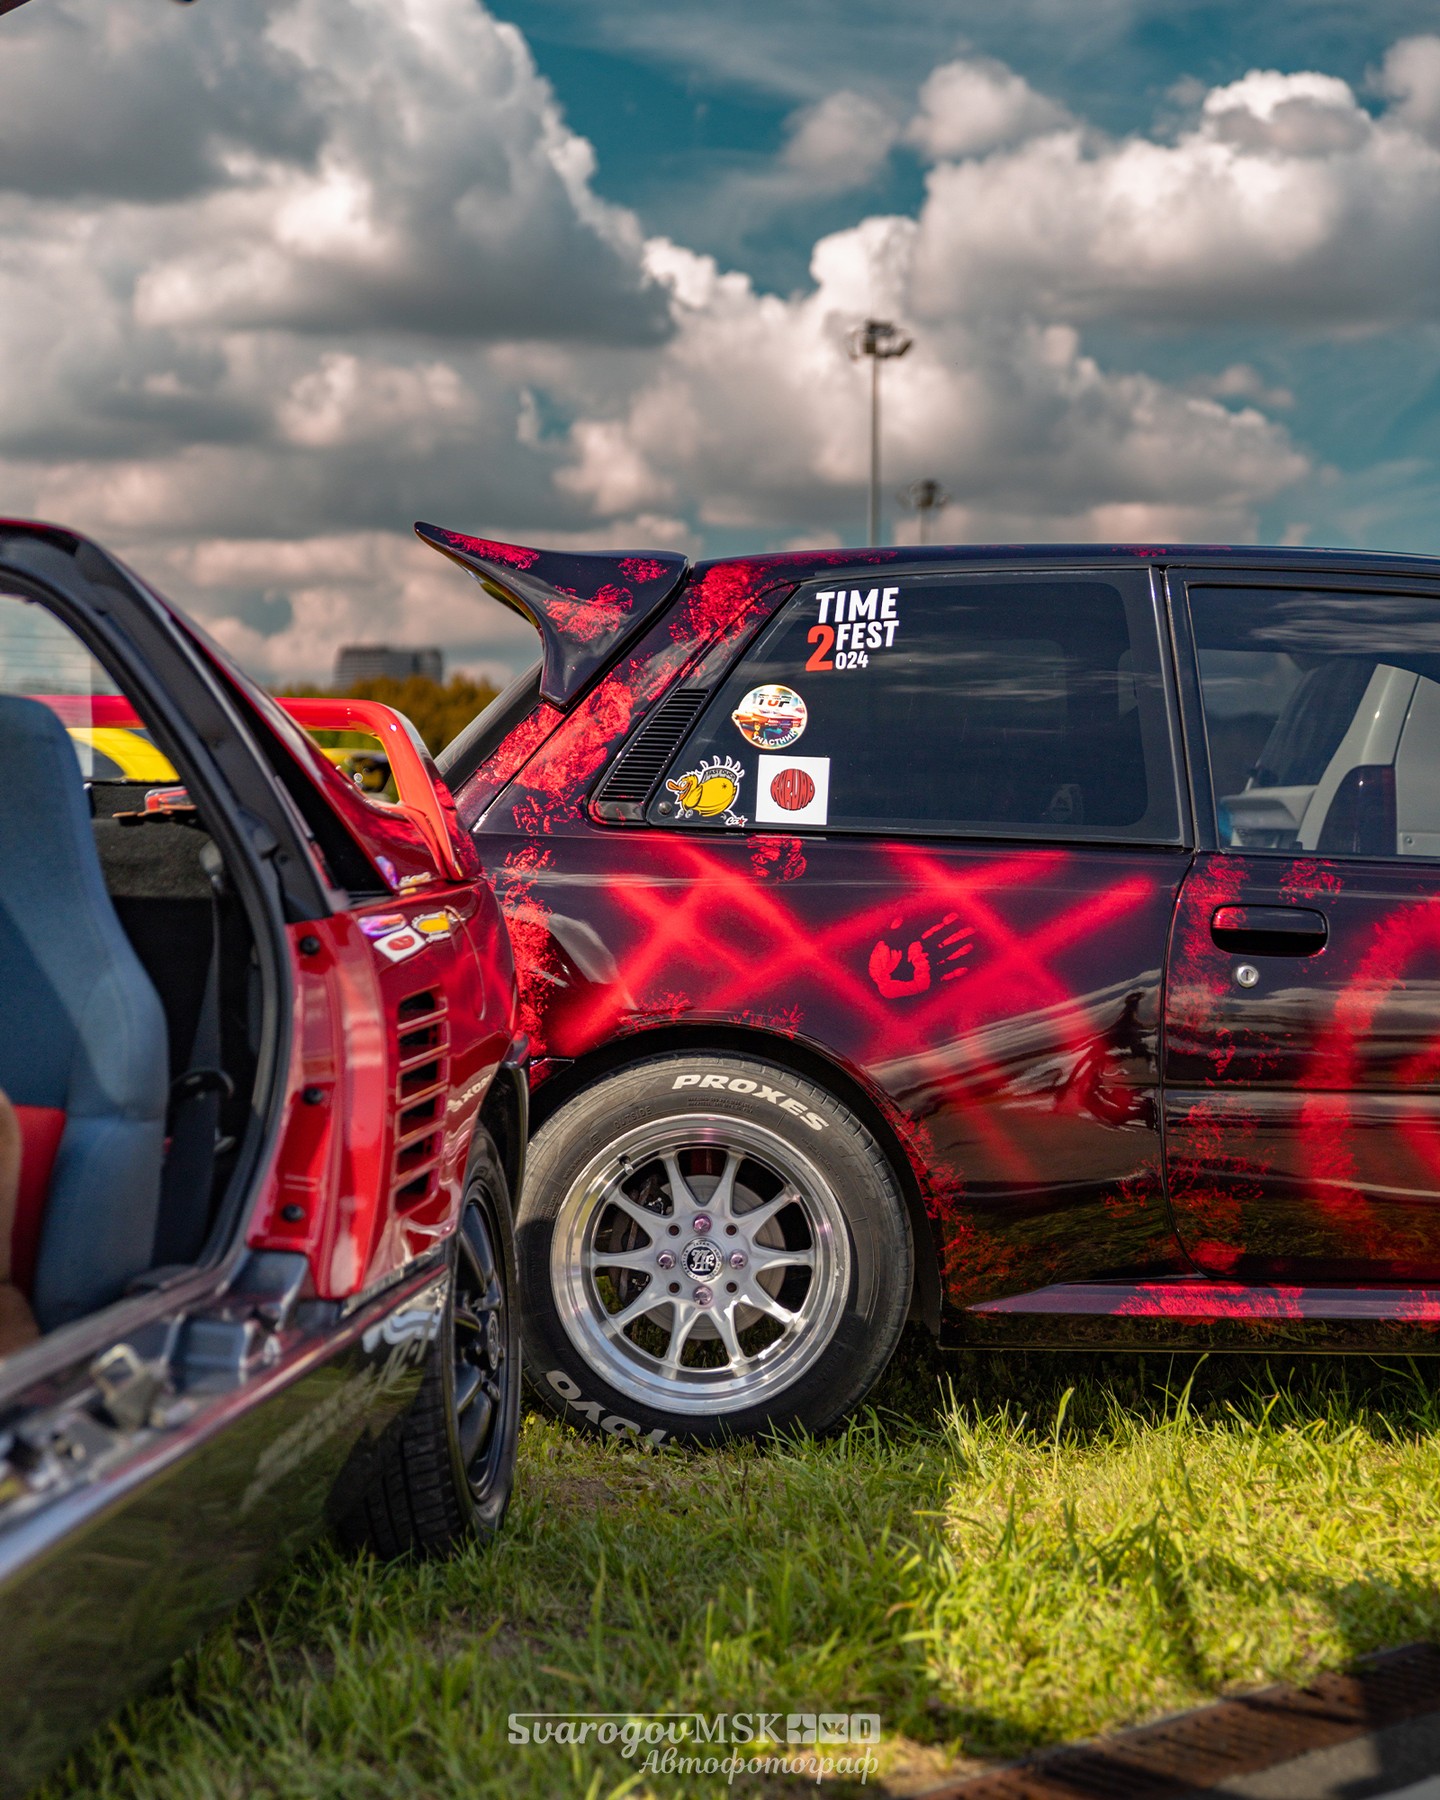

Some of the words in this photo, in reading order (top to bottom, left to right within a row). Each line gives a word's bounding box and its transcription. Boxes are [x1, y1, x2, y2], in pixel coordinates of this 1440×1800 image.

[816, 587, 899, 624] TIME
[805, 624, 835, 672] 2
[836, 620, 900, 651] FEST
[752, 730, 798, 746] УЧАСТНИК
[613, 1105, 653, 1129] OUTSIDE
[672, 1074, 830, 1131] PROXES
